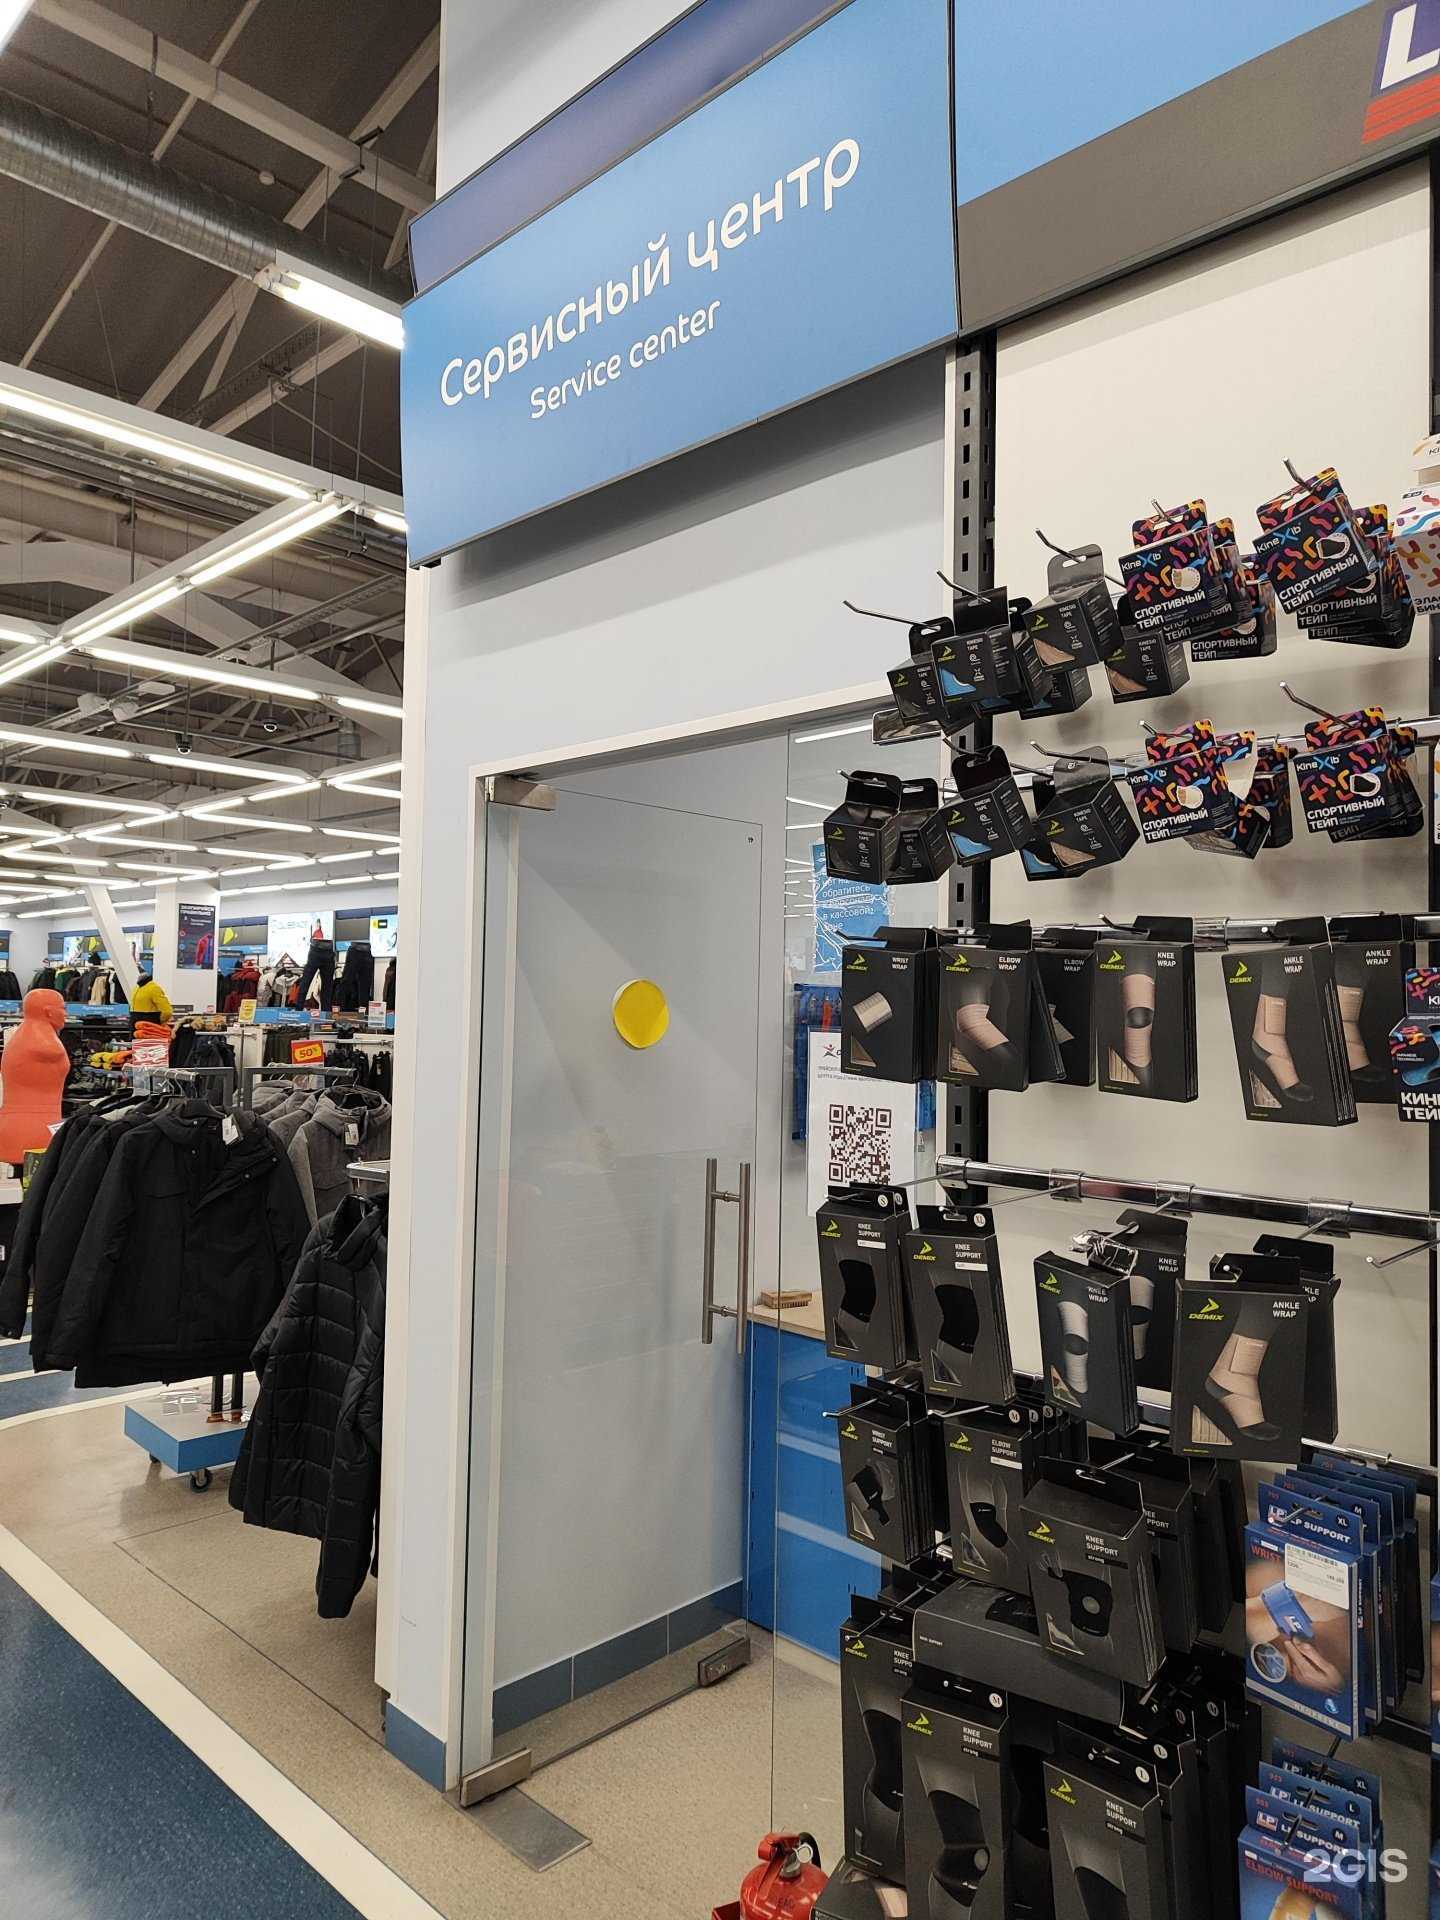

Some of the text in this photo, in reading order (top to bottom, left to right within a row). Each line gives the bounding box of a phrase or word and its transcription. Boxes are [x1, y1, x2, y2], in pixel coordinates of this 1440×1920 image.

[441, 138, 861, 406] Сервисный центр
[530, 300, 721, 420] Service center
[1278, 553, 1360, 600] СПОРТИВНЫЙ
[1134, 589, 1206, 620] СПОРТИВНЫЙ
[1283, 589, 1315, 611] ТЕЙП
[1137, 614, 1165, 630] ТЕЙП
[1299, 613, 1328, 626] ТЕЙП
[1165, 627, 1192, 641] ТЕЙП
[1192, 634, 1258, 651] СПОРТИВНЫЙ
[1192, 650, 1217, 660] ТЕЙП
[1306, 797, 1386, 821] СПОРТИВНЫЙ
[1142, 807, 1209, 831] СПОРТИВНЫЙ
[1309, 816, 1339, 831] ТЕЙП
[1145, 829, 1170, 842] ТЕЙП
[822, 885, 871, 898] обратитесь
[1157, 951, 1175, 960] KNEE
[1365, 949, 1391, 958] ANKLE
[1157, 959, 1177, 968] WRAP
[1283, 955, 1304, 965] ANKLE
[1366, 957, 1388, 966] WRAP
[998, 963, 1018, 972] WRAP
[1063, 965, 1081, 973] WRAP
[1284, 964, 1303, 974] WRAP
[1401, 1092, 1440, 1106] КИН
[1402, 1105, 1440, 1121] ТЕЙ
[858, 1230, 881, 1238] SUPPORT
[955, 1251, 982, 1260] SUPPORT
[1158, 1257, 1178, 1266] KNEE
[1158, 1264, 1179, 1273] WRAP
[1088, 1294, 1109, 1304] WRAP
[1272, 1301, 1300, 1310] ANKLE
[1189, 1313, 1224, 1321] DEMIX
[1272, 1309, 1297, 1319] WRAP
[991, 1446, 1017, 1458] SUPPORT
[1146, 1518, 1170, 1529] PPORT
[1337, 1516, 1348, 1527] XL
[1304, 1521, 1351, 1544] SUPPORT
[1085, 1534, 1105, 1546] KNEE
[1086, 1542, 1119, 1557] SUPPORT
[894, 1650, 910, 1660] KNEE
[894, 1657, 913, 1668] SUPPO
[963, 1726, 981, 1738] KNEE
[963, 1734, 993, 1750] SUPPORT
[1356, 1779, 1367, 1790] XL
[1271, 1786, 1288, 1800] LP
[1105, 1800, 1125, 1815] KNEE
[1106, 1808, 1137, 1830] SUPPORT
[1258, 1813, 1275, 1824] LP
[1309, 1804, 1361, 1827] SUPPORT
[1334, 1830, 1344, 1840] M
[1297, 1830, 1349, 1856] SUPPORT
[1246, 1860, 1284, 1882] ELBOW
